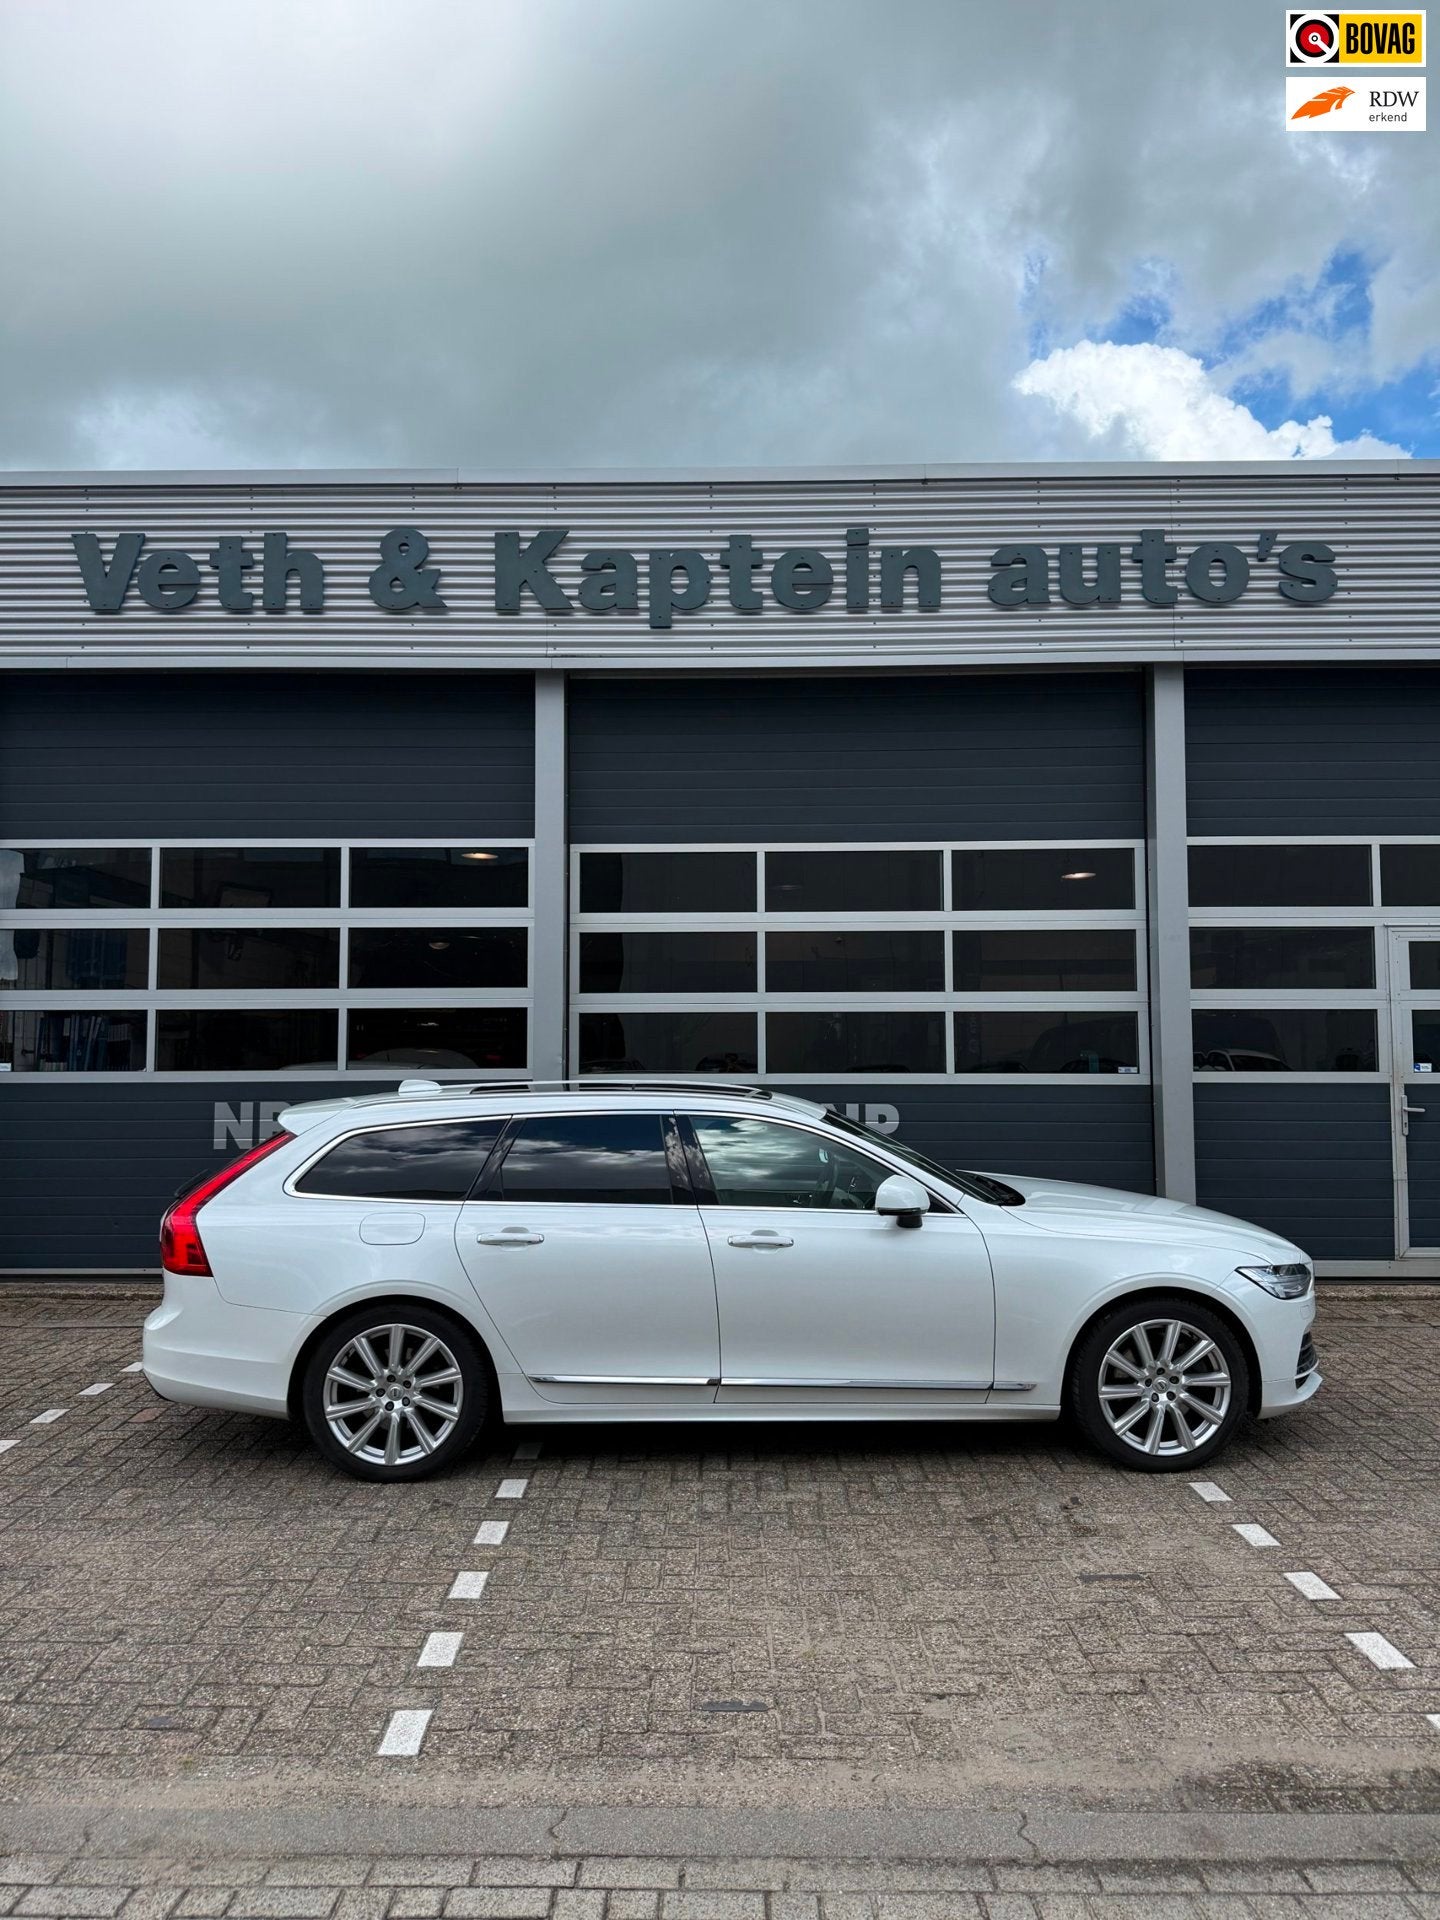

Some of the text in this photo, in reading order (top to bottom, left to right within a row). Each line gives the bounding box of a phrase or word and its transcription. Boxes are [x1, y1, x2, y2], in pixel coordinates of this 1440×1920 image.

[71, 528, 1339, 629] Veth & Kaptein auto's
